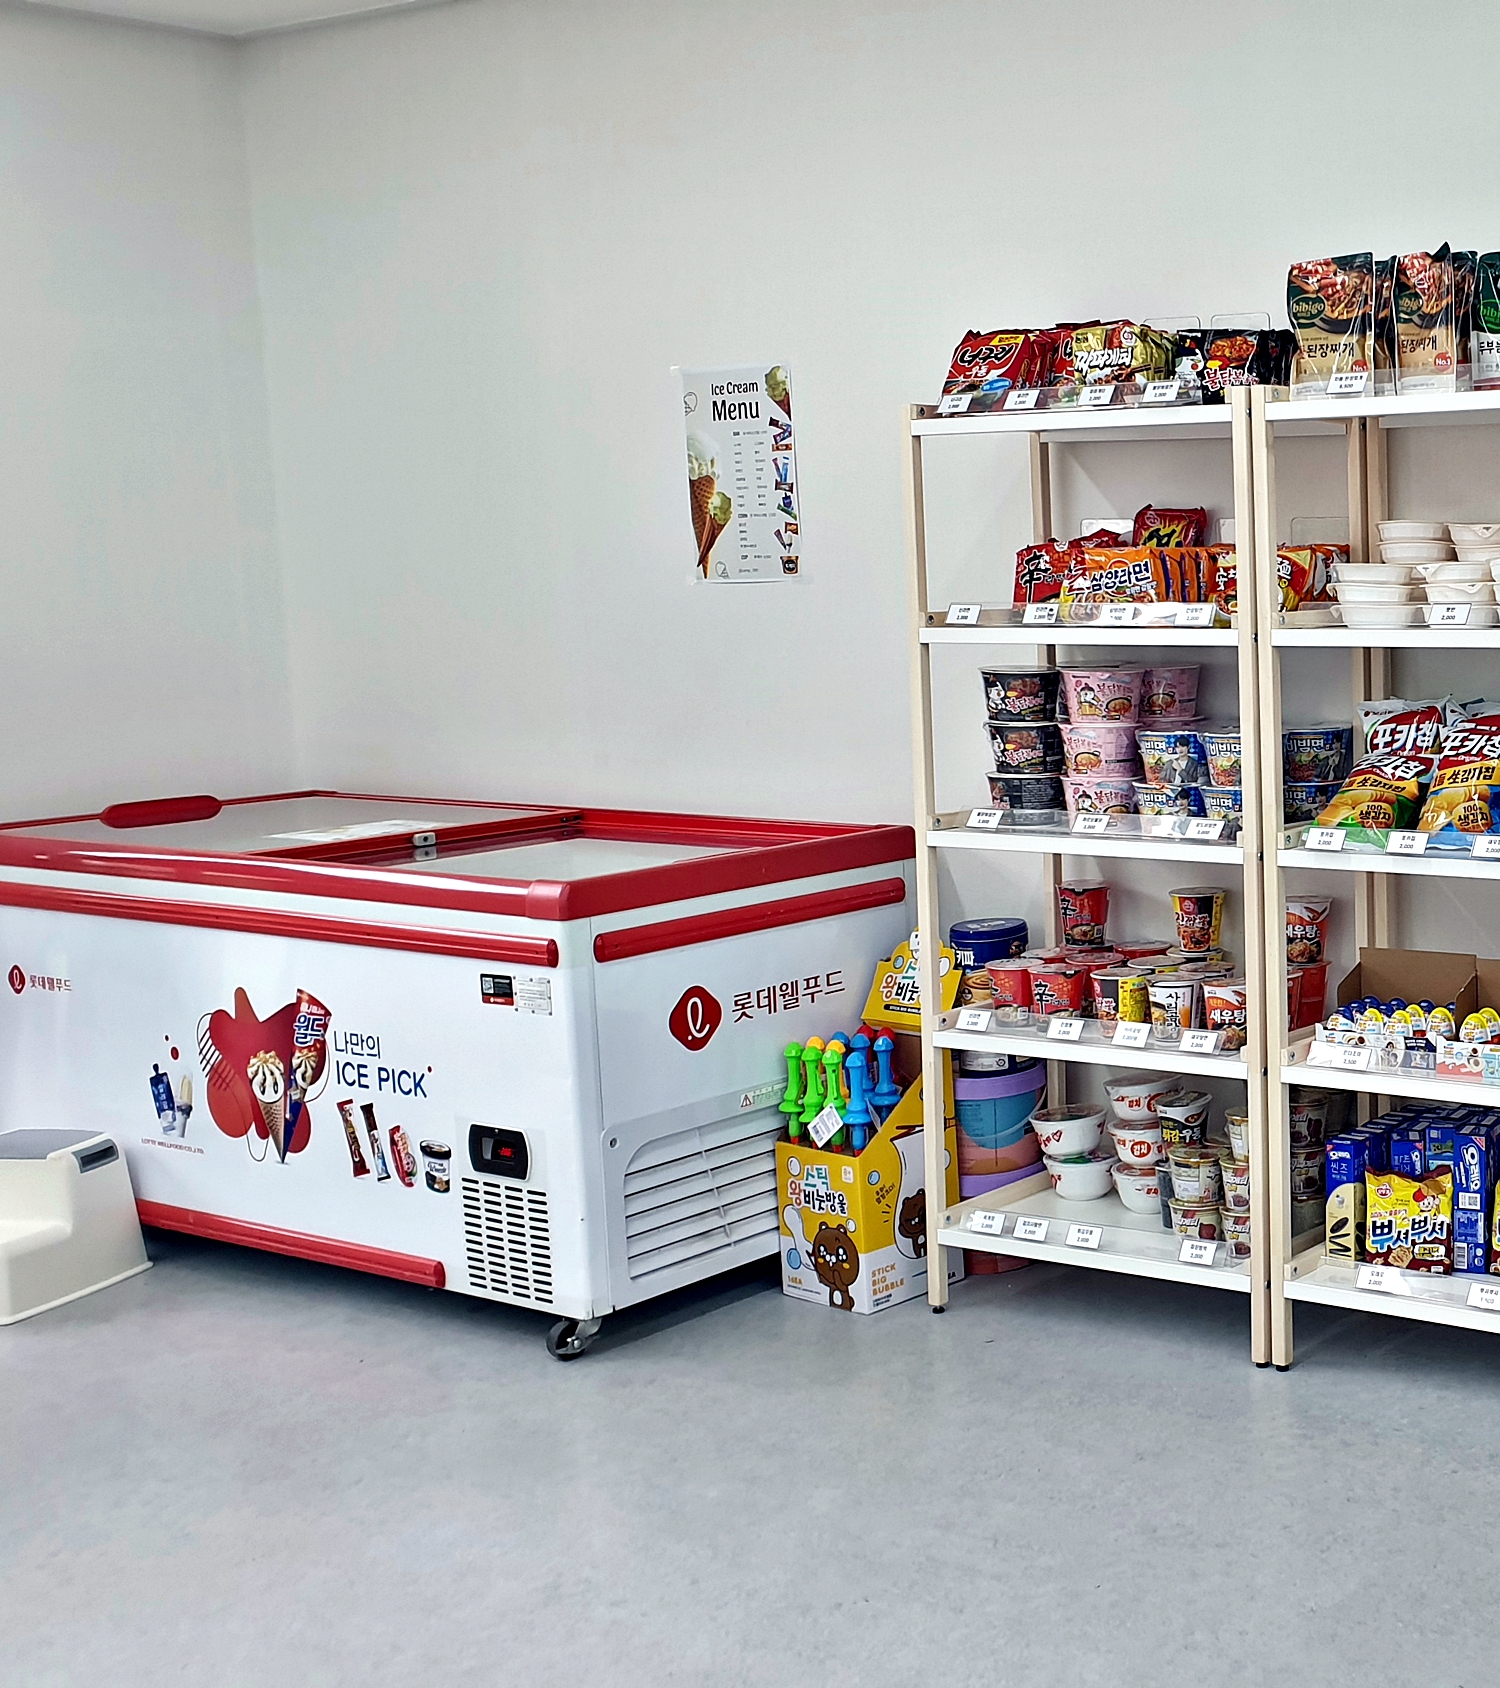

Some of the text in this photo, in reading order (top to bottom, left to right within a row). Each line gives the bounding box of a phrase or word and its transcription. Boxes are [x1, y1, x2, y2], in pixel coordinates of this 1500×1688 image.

[1293, 301, 1324, 315] bibigo
[958, 343, 1015, 367] 너구리
[1074, 348, 1134, 375] 짜파게티
[1435, 358, 1451, 366] No.1
[711, 381, 759, 396] Ice Cream
[712, 400, 760, 422] Menu
[1019, 551, 1053, 603] 辛
[1090, 559, 1152, 593] 삼양라면
[1373, 720, 1441, 755] 포카칩
[1358, 810, 1392, 823] 생감자
[1457, 812, 1489, 827] 생감자
[731, 970, 846, 1024] 롯데웰푸드
[882, 973, 897, 1000] 왕
[1034, 979, 1056, 1019] 辛
[1209, 1009, 1247, 1025] 새우탕
[293, 1014, 324, 1045] 월드
[334, 1030, 381, 1060] 나만의
[336, 1060, 427, 1098] ICE PICK
[1133, 1143, 1151, 1156] 김치
[804, 1166, 829, 1190] 스틱
[1330, 1161, 1349, 1174] 씬즈
[1466, 1145, 1481, 1190] 오레오
[789, 1180, 847, 1215] 왕 비눗방울
[1371, 1216, 1446, 1250] 뿌셔뿌셔
[871, 1263, 896, 1279] STICK
[871, 1277, 888, 1288] BIG
[872, 1278, 905, 1296] BUBBLE
